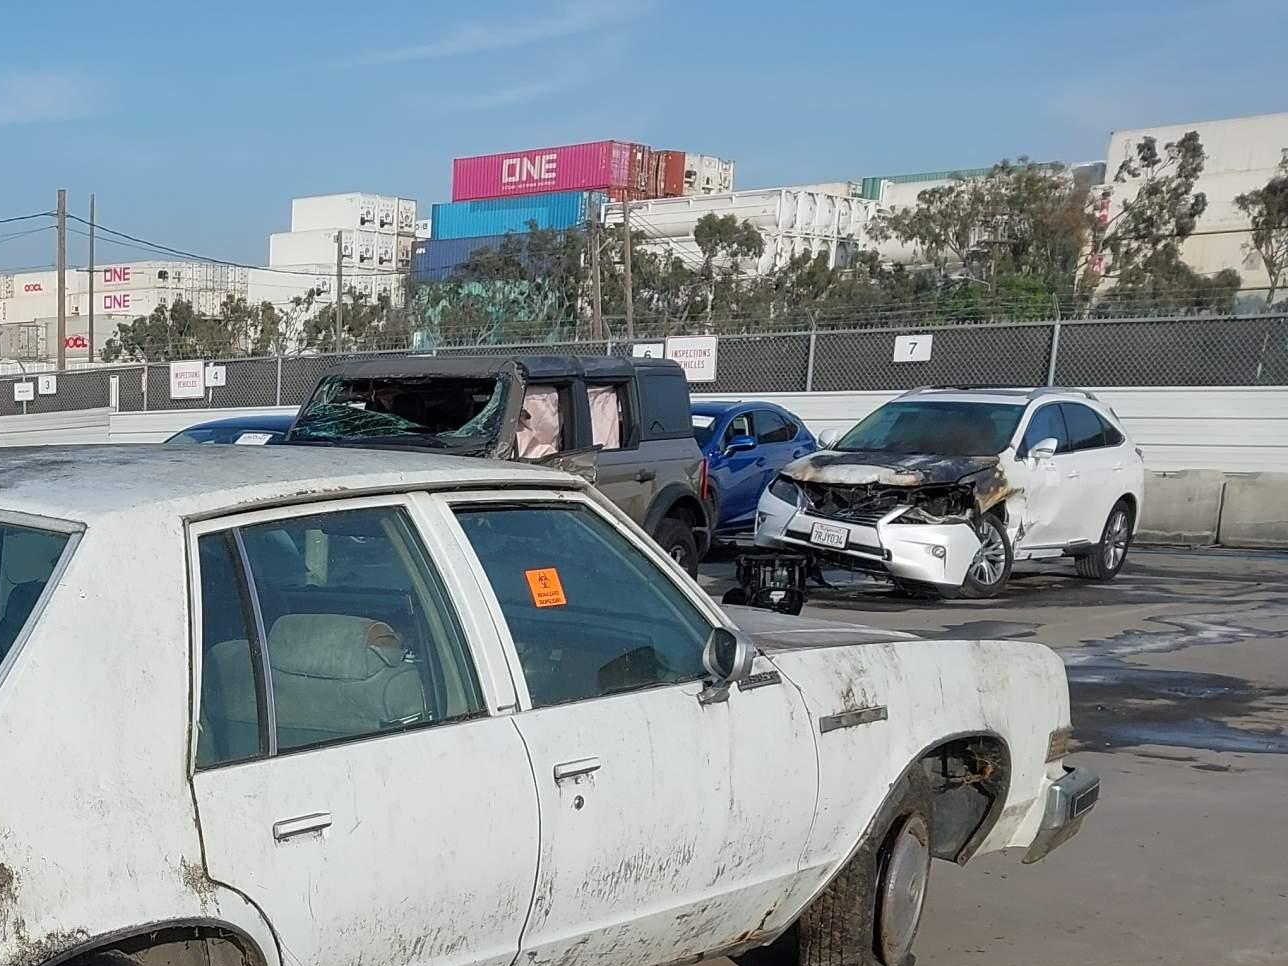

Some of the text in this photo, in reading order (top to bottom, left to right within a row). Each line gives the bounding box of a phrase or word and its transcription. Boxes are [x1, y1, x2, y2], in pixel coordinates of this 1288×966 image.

[502, 153, 558, 183] ONE
[104, 266, 130, 282] ONE
[104, 294, 130, 309] ONE
[671, 349, 711, 358] INSPECTIONS
[908, 342, 918, 355] 7
[644, 350, 652, 359] 6
[679, 360, 705, 369] EHICLES
[213, 371, 219, 380] 4
